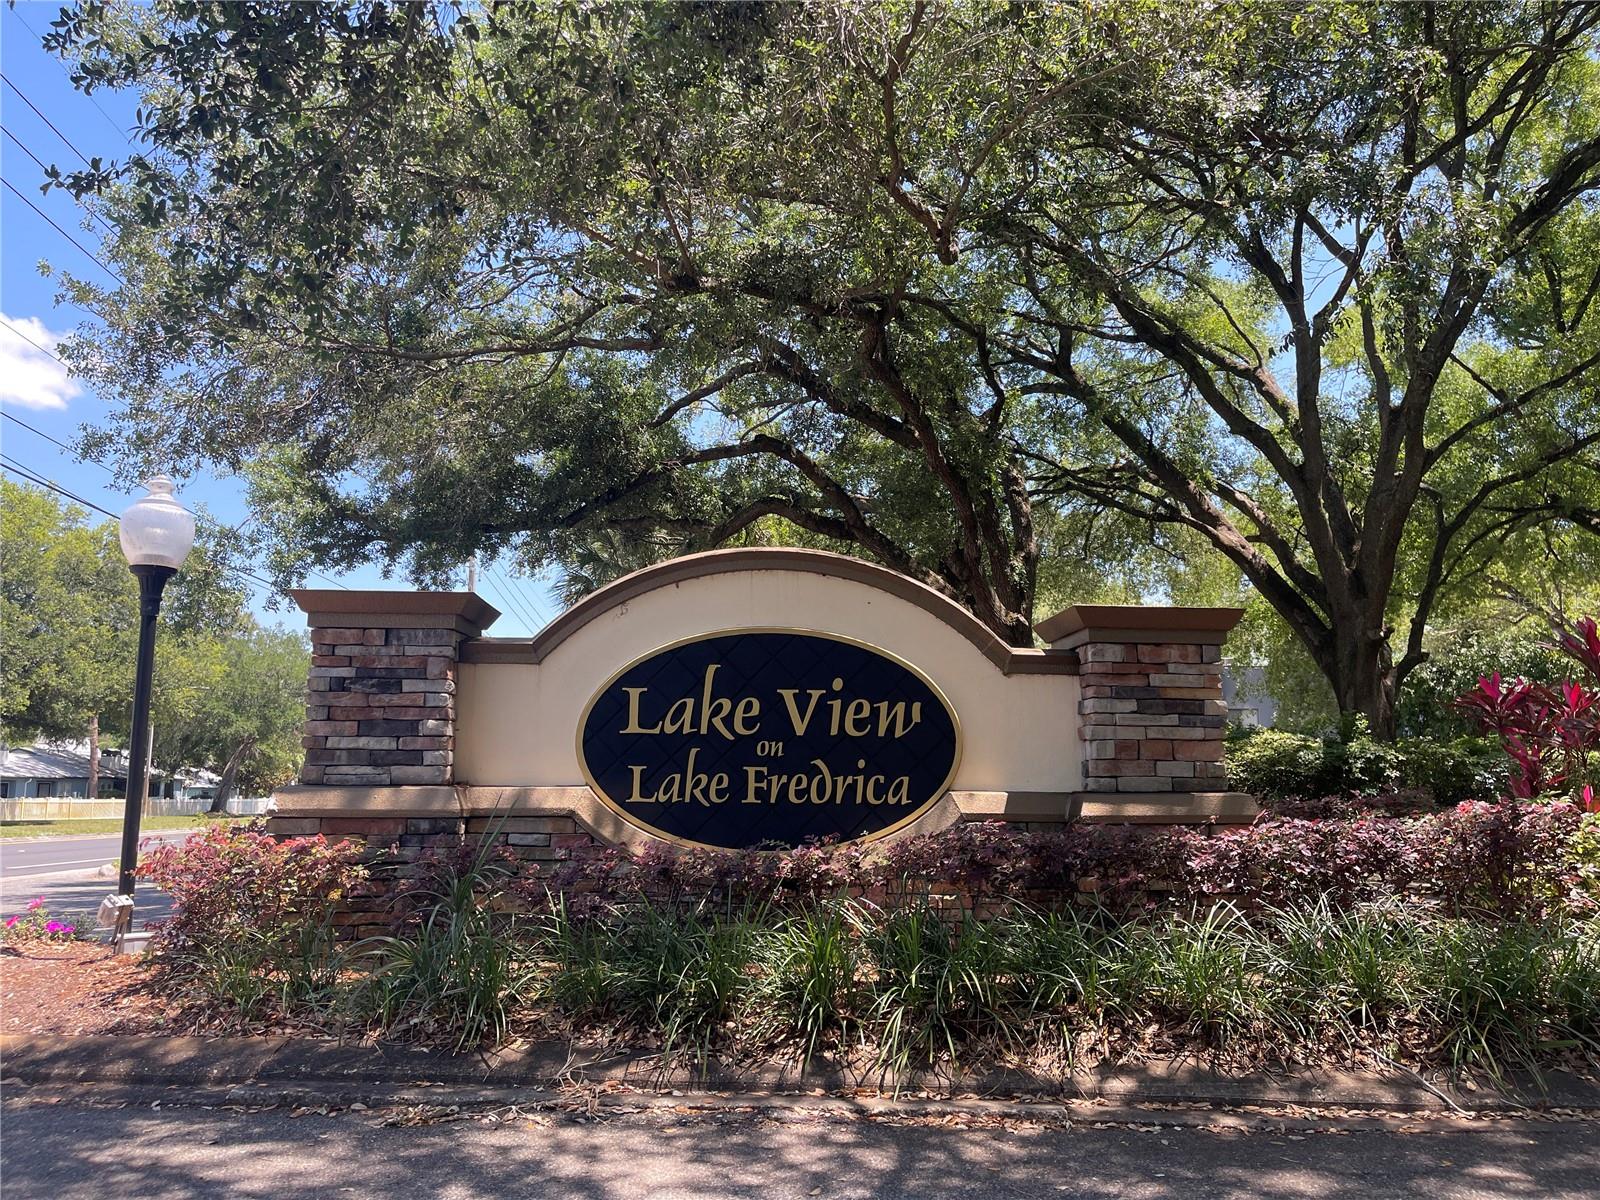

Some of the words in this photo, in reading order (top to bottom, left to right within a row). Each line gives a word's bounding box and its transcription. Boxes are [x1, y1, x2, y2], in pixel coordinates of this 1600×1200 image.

[619, 664, 761, 741] Lake
[777, 677, 922, 739] View
[625, 748, 731, 807] Lake
[741, 759, 913, 806] Fredrica
[757, 740, 785, 757] on
